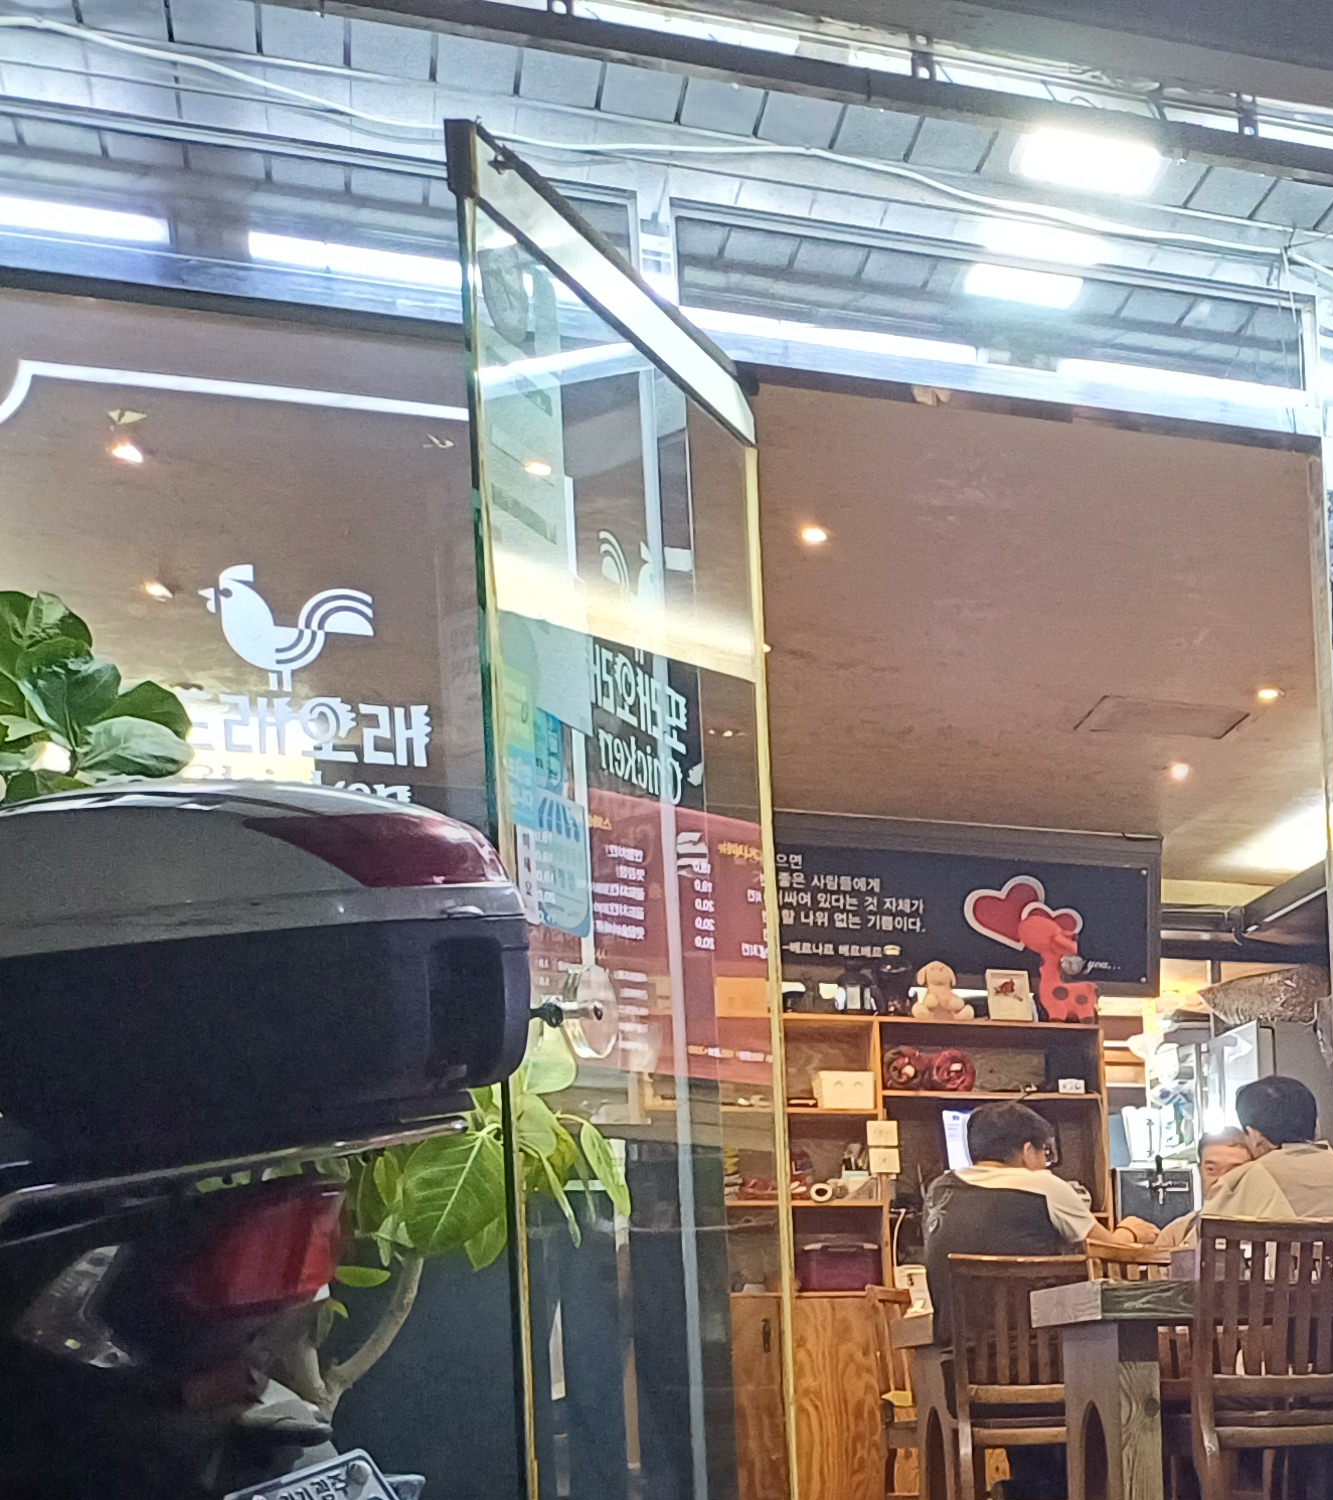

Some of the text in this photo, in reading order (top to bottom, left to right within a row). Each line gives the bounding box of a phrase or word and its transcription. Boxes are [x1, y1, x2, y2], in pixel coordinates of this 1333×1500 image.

[776, 854, 803, 869] 으면
[779, 890, 811, 907] 싸여
[817, 892, 859, 910] 있다는
[864, 896, 878, 912] 것
[800, 911, 829, 928] 나위
[833, 912, 862, 929] 없는
